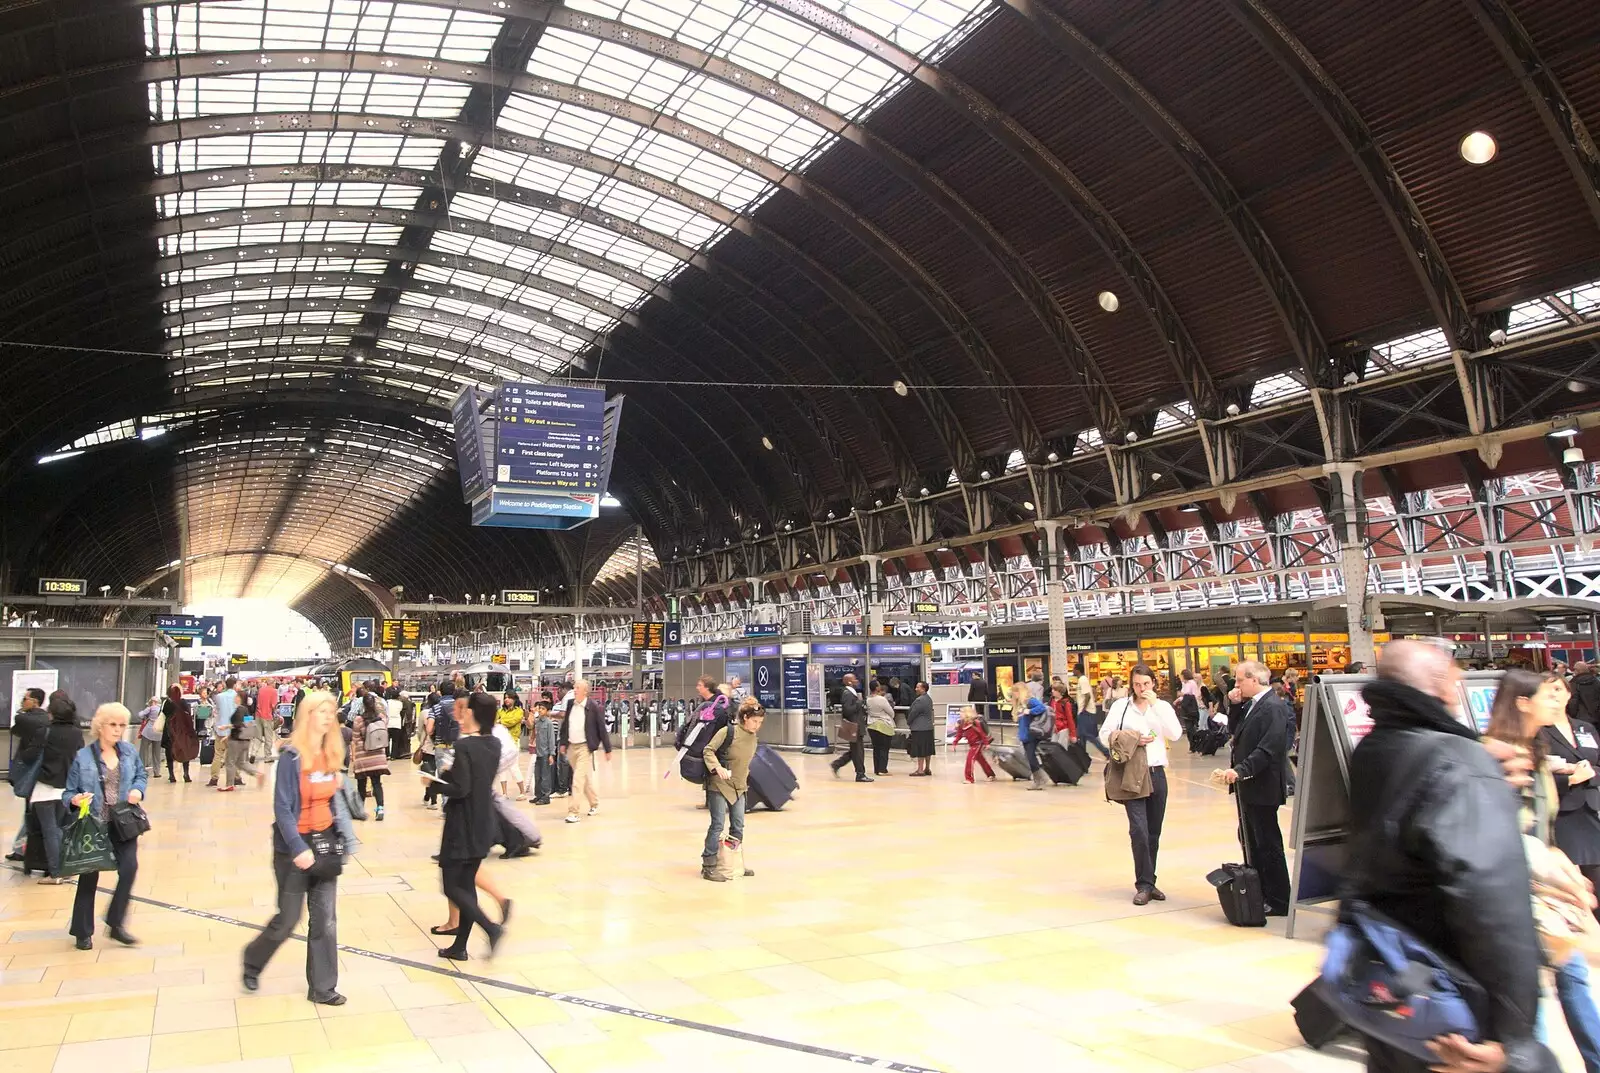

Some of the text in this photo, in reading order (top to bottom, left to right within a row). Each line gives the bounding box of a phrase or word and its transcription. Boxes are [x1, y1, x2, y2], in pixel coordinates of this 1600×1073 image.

[45, 582, 71, 591] 10:39
[508, 593, 528, 601] 10:39
[207, 625, 217, 638] 4
[359, 627, 368, 639] 5
[670, 630, 677, 641] 6
